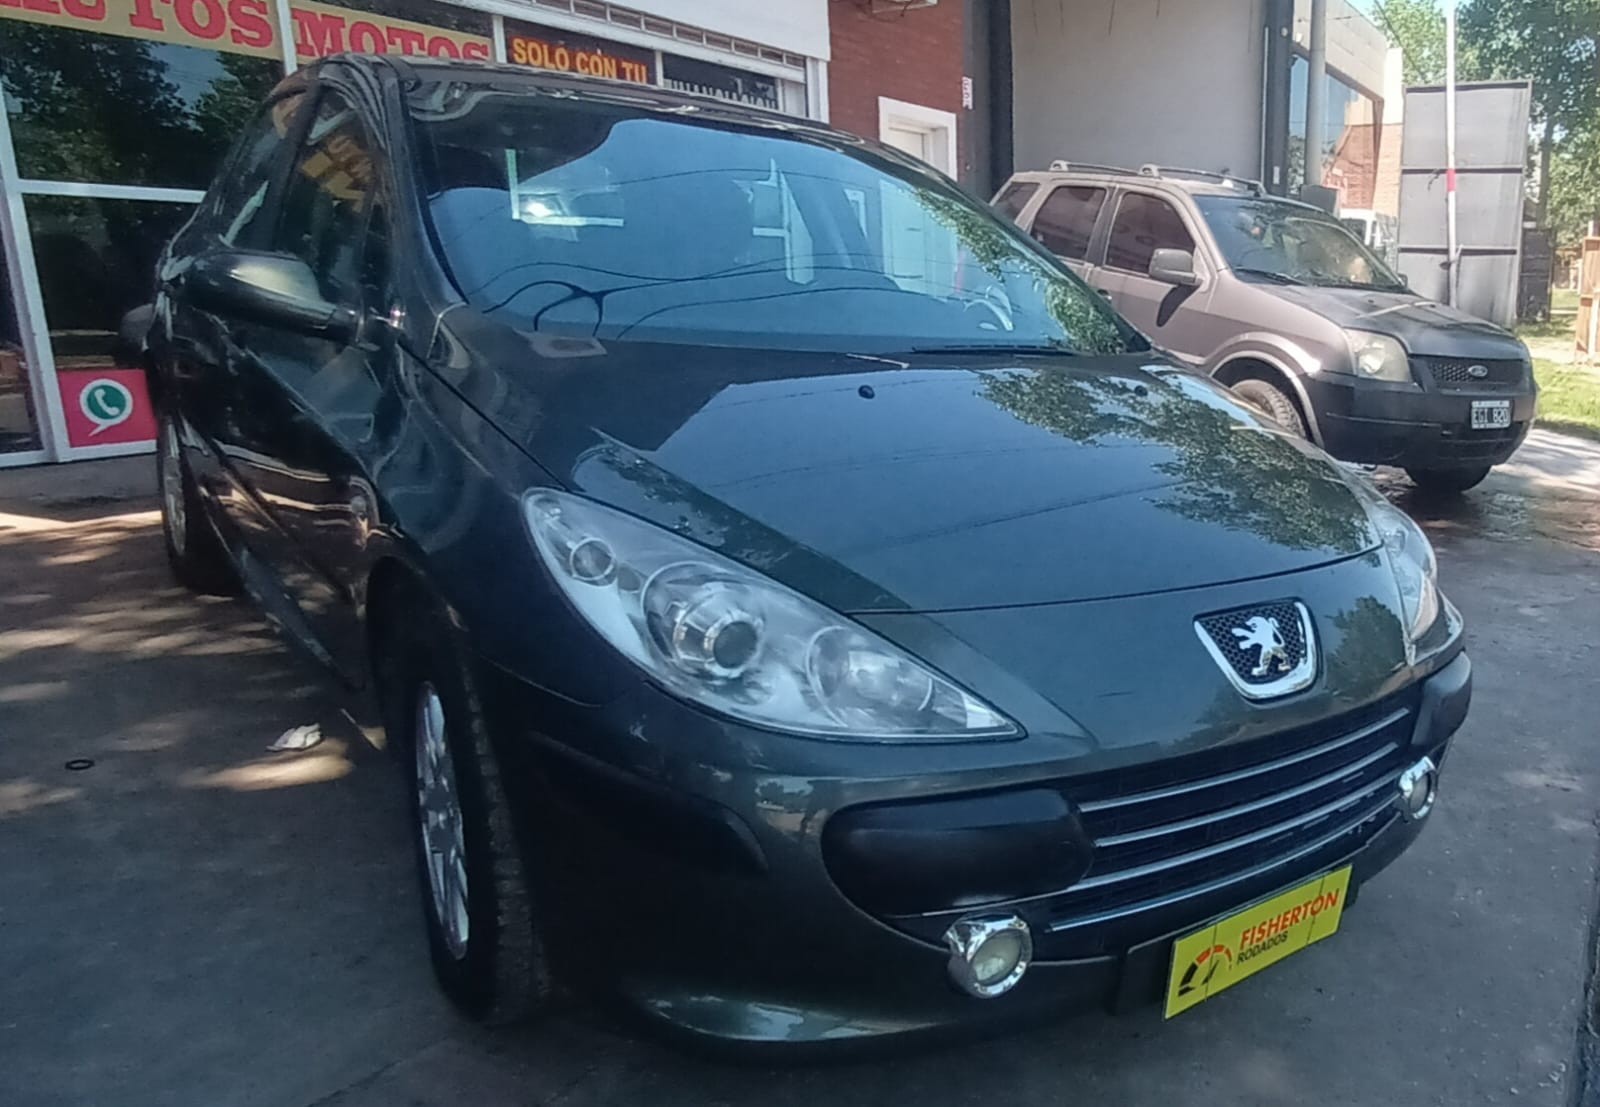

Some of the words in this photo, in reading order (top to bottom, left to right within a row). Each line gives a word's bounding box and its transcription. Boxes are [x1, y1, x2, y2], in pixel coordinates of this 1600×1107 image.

[0, 0, 273, 48] TOS
[576, 52, 617, 79] CON
[1240, 888, 1340, 950] FISHERTON
[1236, 930, 1289, 965] RODADOS
